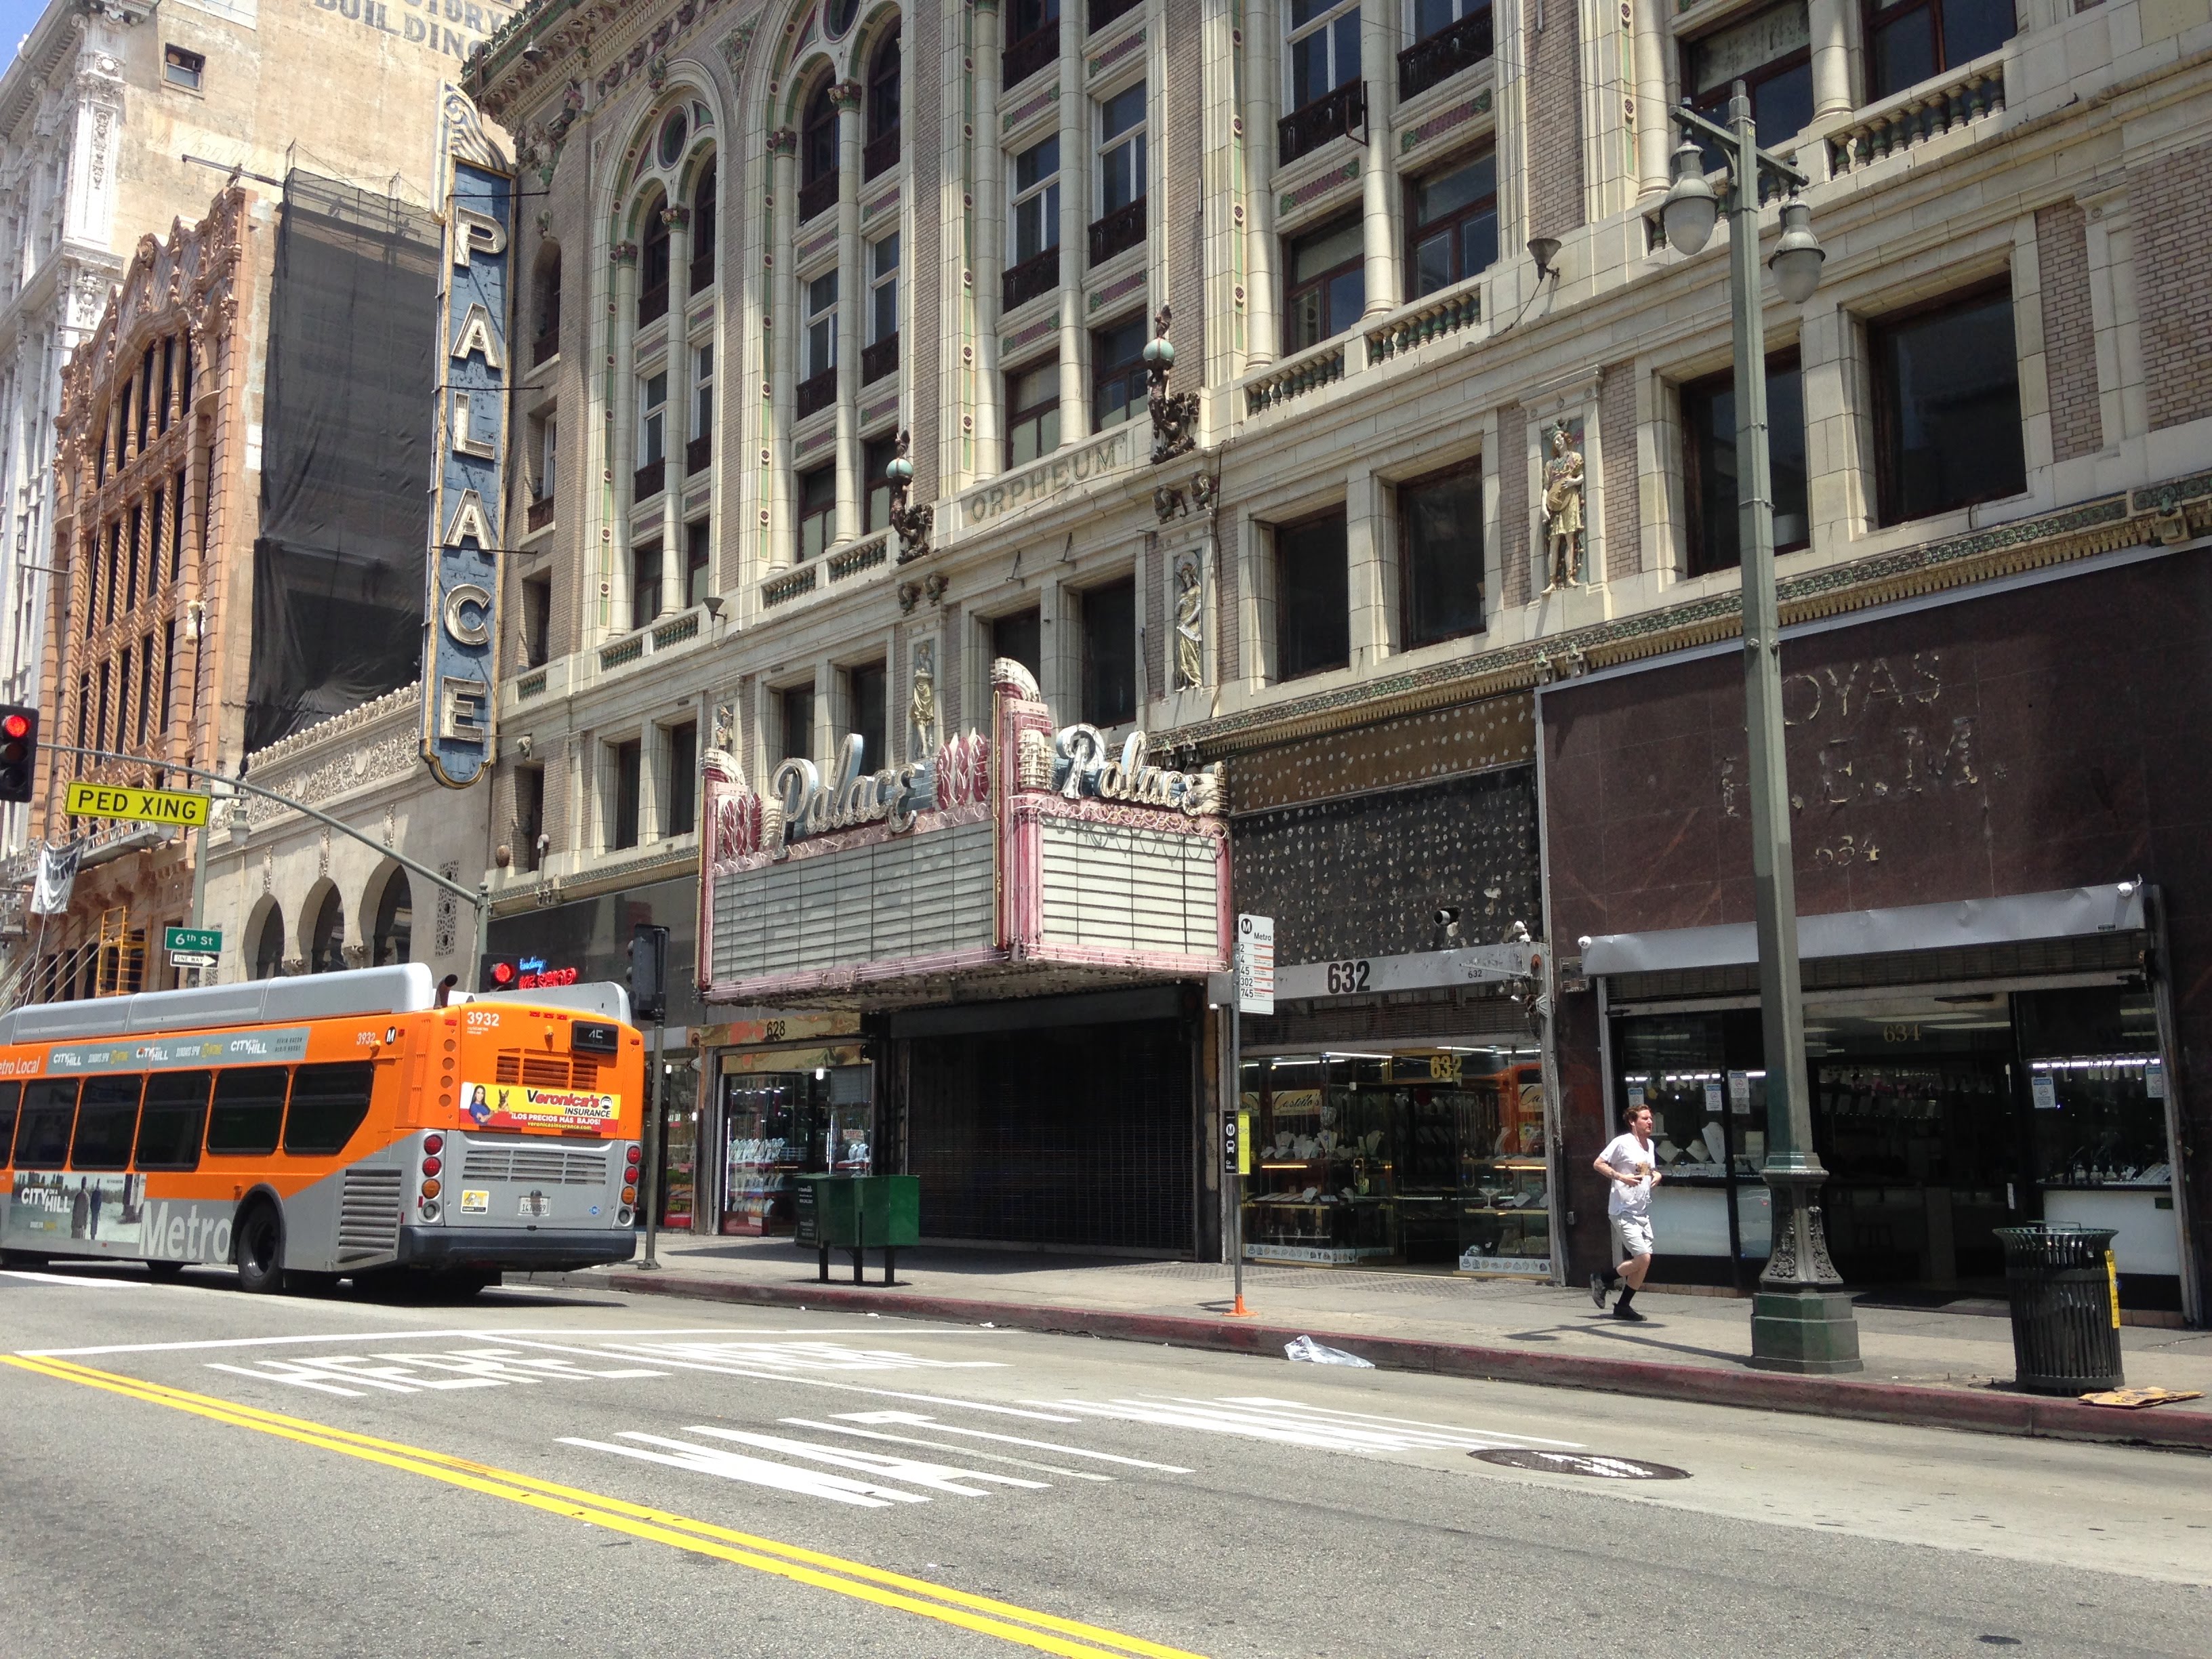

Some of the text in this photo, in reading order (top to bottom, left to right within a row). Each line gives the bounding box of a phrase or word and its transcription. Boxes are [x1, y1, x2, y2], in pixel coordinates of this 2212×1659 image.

[441, 205, 508, 743] PALACE
[972, 436, 1117, 523] ORPHEUM
[1056, 723, 1216, 815] Palace
[78, 790, 196, 819] PED XING
[176, 933, 213, 945] 6th St
[1254, 933, 1271, 941] Metro
[1240, 944, 1245, 953] 2
[1240, 955, 1245, 963] 4
[1240, 966, 1250, 975] 45
[1327, 960, 1370, 994] 632
[1468, 970, 1483, 979] 632
[1240, 977, 1253, 987] 302
[1240, 988, 1254, 998] 745
[467, 1011, 499, 1027] 3932
[766, 1020, 785, 1036] 628
[230, 1040, 250, 1052] CITY
[356, 1031, 376, 1045] 3932
[247, 1042, 267, 1054] HILL
[16, 1056, 41, 1074] Local
[54, 1052, 68, 1064] CITY
[66, 1055, 81, 1066] HILL
[1430, 1055, 1462, 1079] 632
[527, 1090, 600, 1108] Veronica's
[1274, 1092, 1319, 1110] Castillo's
[565, 1107, 611, 1118] INSURANCE
[527, 1122, 592, 1130] veronicasinsurance.com
[21, 1187, 48, 1205] CITY
[45, 1195, 70, 1213] HILL
[138, 1201, 232, 1263] Metro
[205, 1348, 672, 1396] HERE
[554, 1410, 1196, 1507] WAIT
